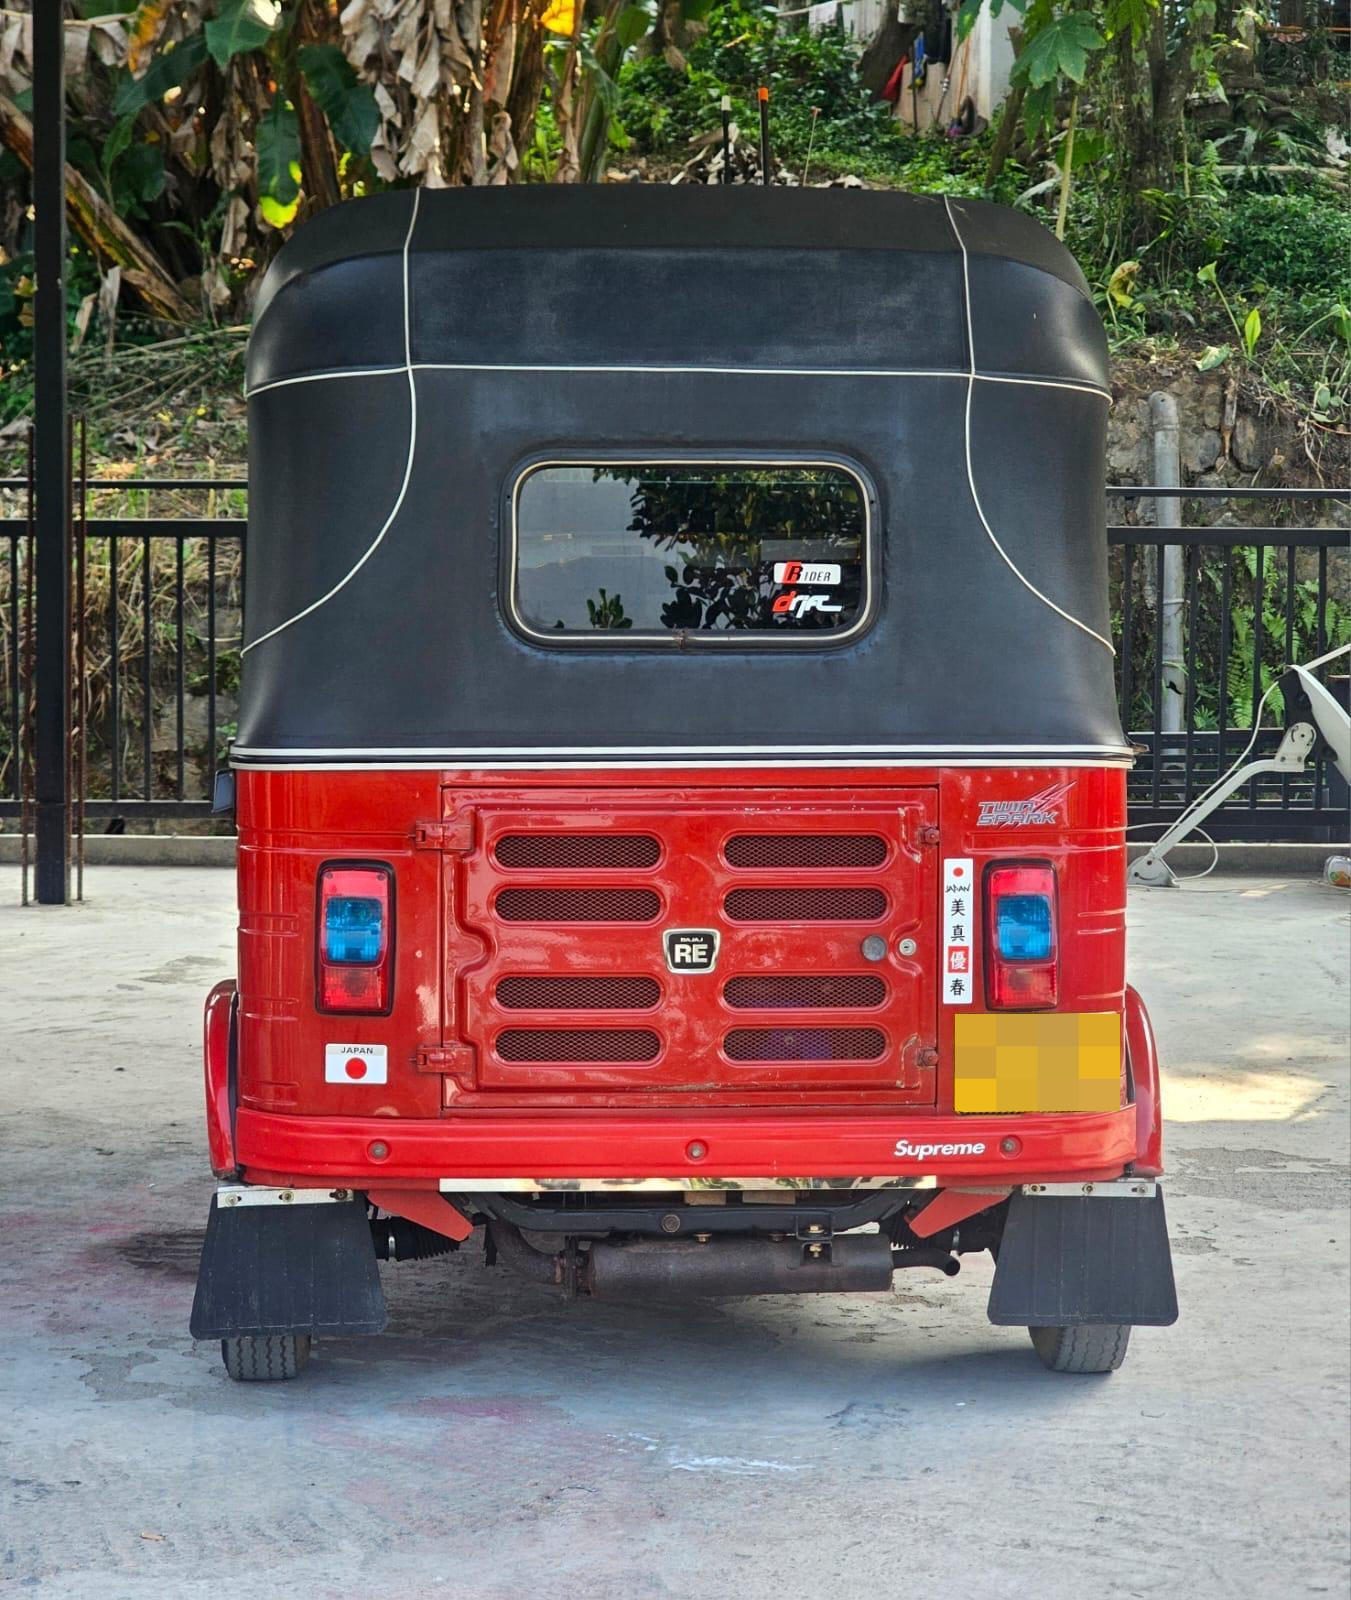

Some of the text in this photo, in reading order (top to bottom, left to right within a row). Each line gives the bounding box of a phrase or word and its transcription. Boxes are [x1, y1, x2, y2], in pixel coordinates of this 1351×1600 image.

[784, 562, 831, 583] RIDER
[978, 801, 1034, 814] TWIN
[976, 811, 1058, 826] SPARK
[674, 943, 708, 963] RE
[894, 1139, 985, 1160] Supreme
